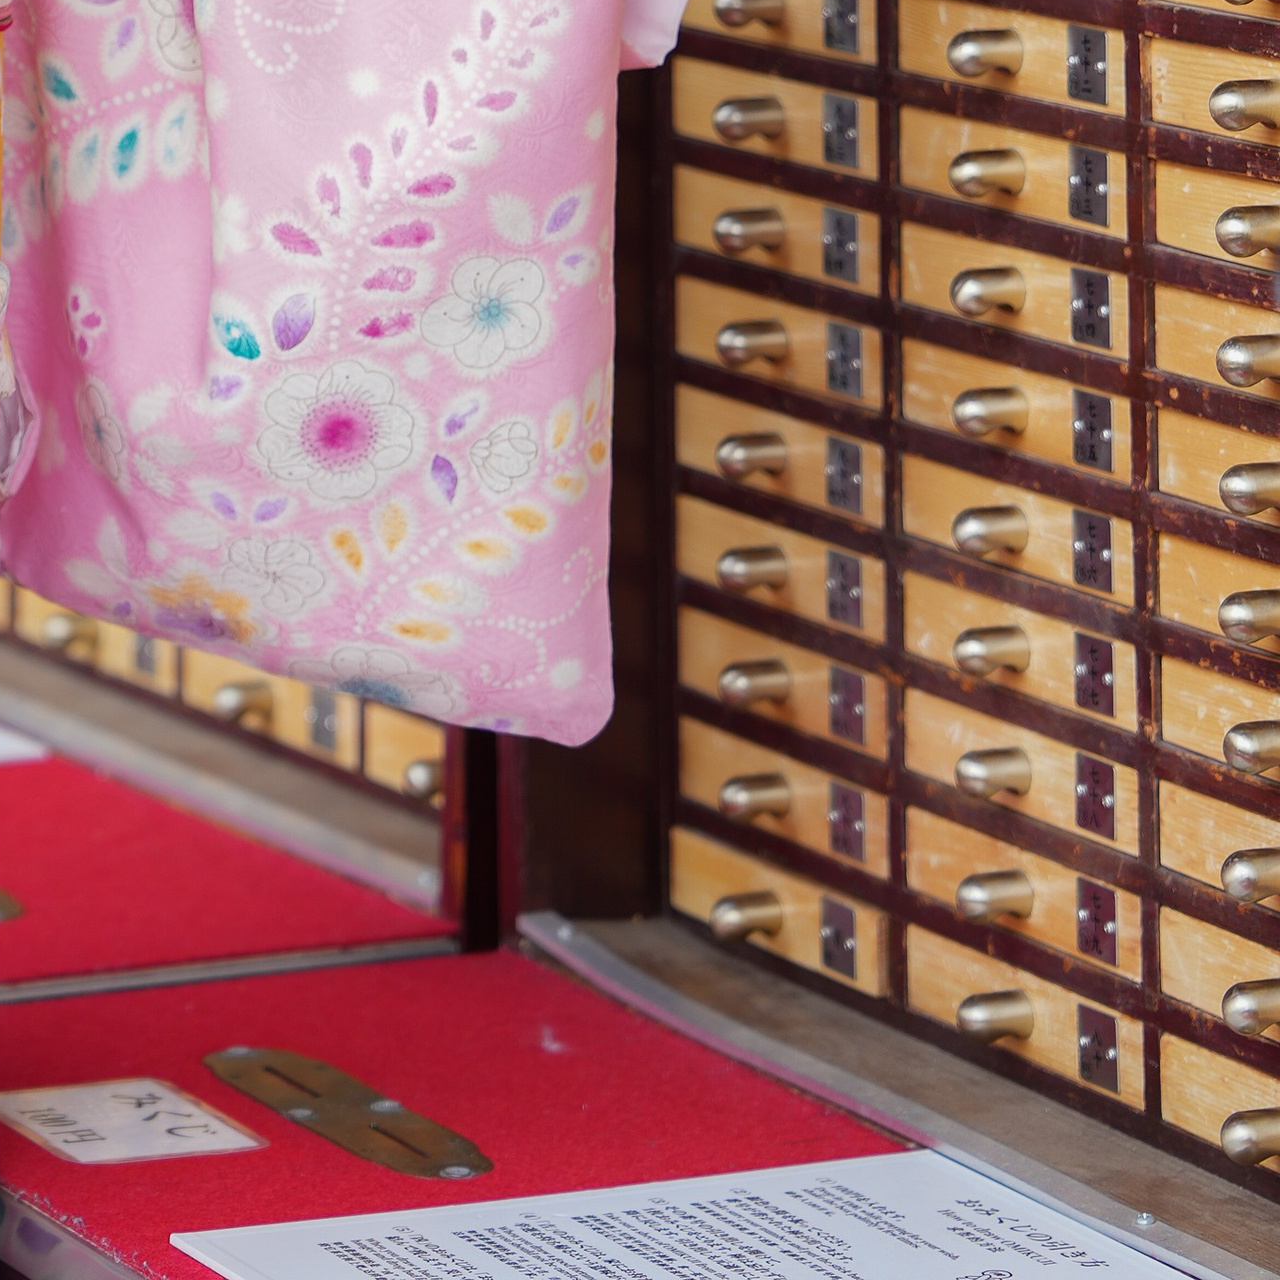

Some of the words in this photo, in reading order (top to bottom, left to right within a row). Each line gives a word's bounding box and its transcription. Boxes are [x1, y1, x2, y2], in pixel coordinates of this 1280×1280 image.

[19, 1107, 108, 1144] 100円
[110, 1093, 218, 1138] みくじ
[936, 1208, 969, 1221] How
[972, 1226, 1008, 1240] draw
[998, 1239, 1057, 1265] OMIKUJI
[955, 1197, 1111, 1268] おみくじの引き方
